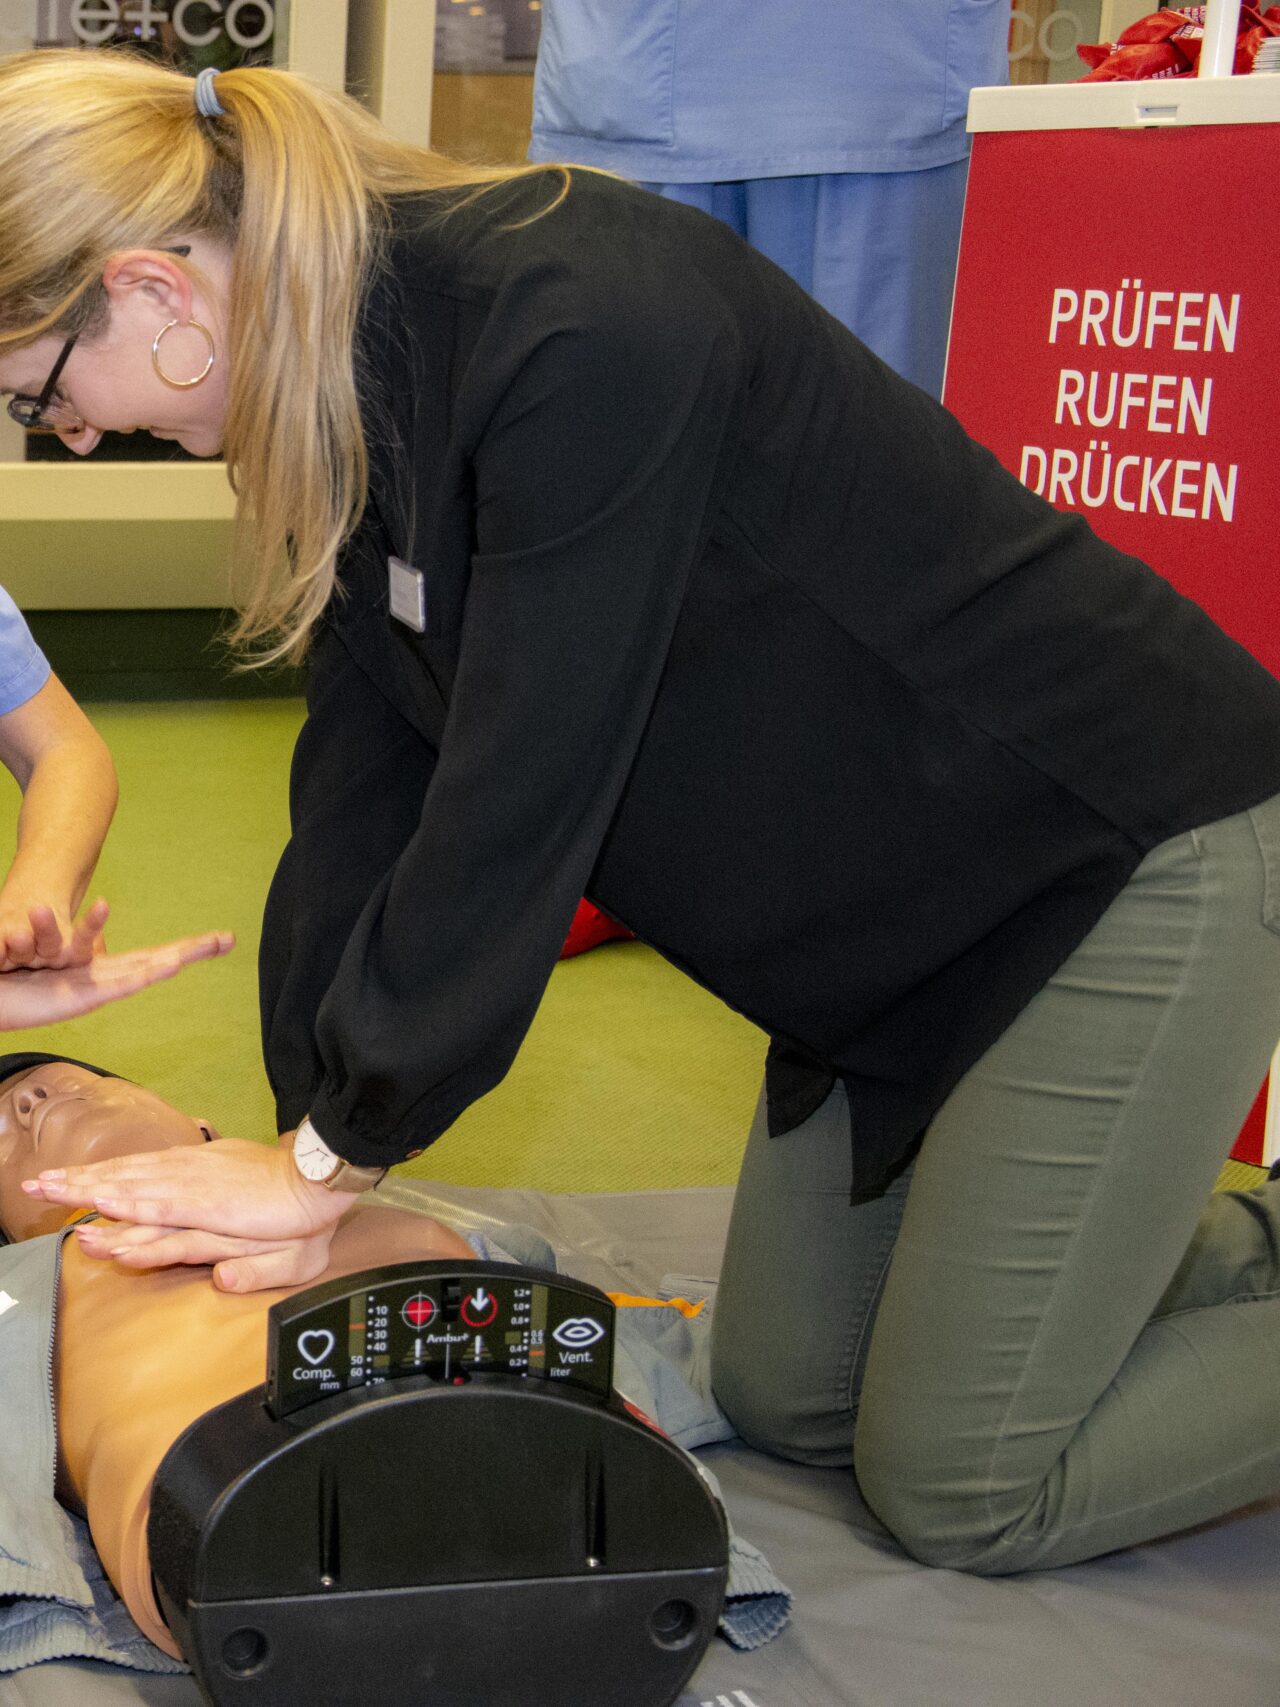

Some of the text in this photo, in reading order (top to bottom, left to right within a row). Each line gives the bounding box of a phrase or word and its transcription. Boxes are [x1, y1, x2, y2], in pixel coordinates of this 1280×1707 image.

[1048, 278, 1241, 353] PRÜFEN
[1055, 369, 1213, 436] RUFEN
[1019, 440, 1239, 522] DRÜCKEN
[513, 1289, 525, 1297] 1.2
[375, 1305, 388, 1315] 10
[513, 1303, 524, 1311] 1.0
[374, 1317, 387, 1327] 20
[374, 1330, 387, 1340] 30
[373, 1342, 387, 1351] 40
[350, 1355, 363, 1365] 50
[509, 1358, 522, 1367] 0.2
[559, 1351, 593, 1364] Vent.
[293, 1367, 336, 1381] Comp.
[350, 1367, 363, 1377] 60
[550, 1367, 571, 1377] liter
[320, 1381, 340, 1391] mm
